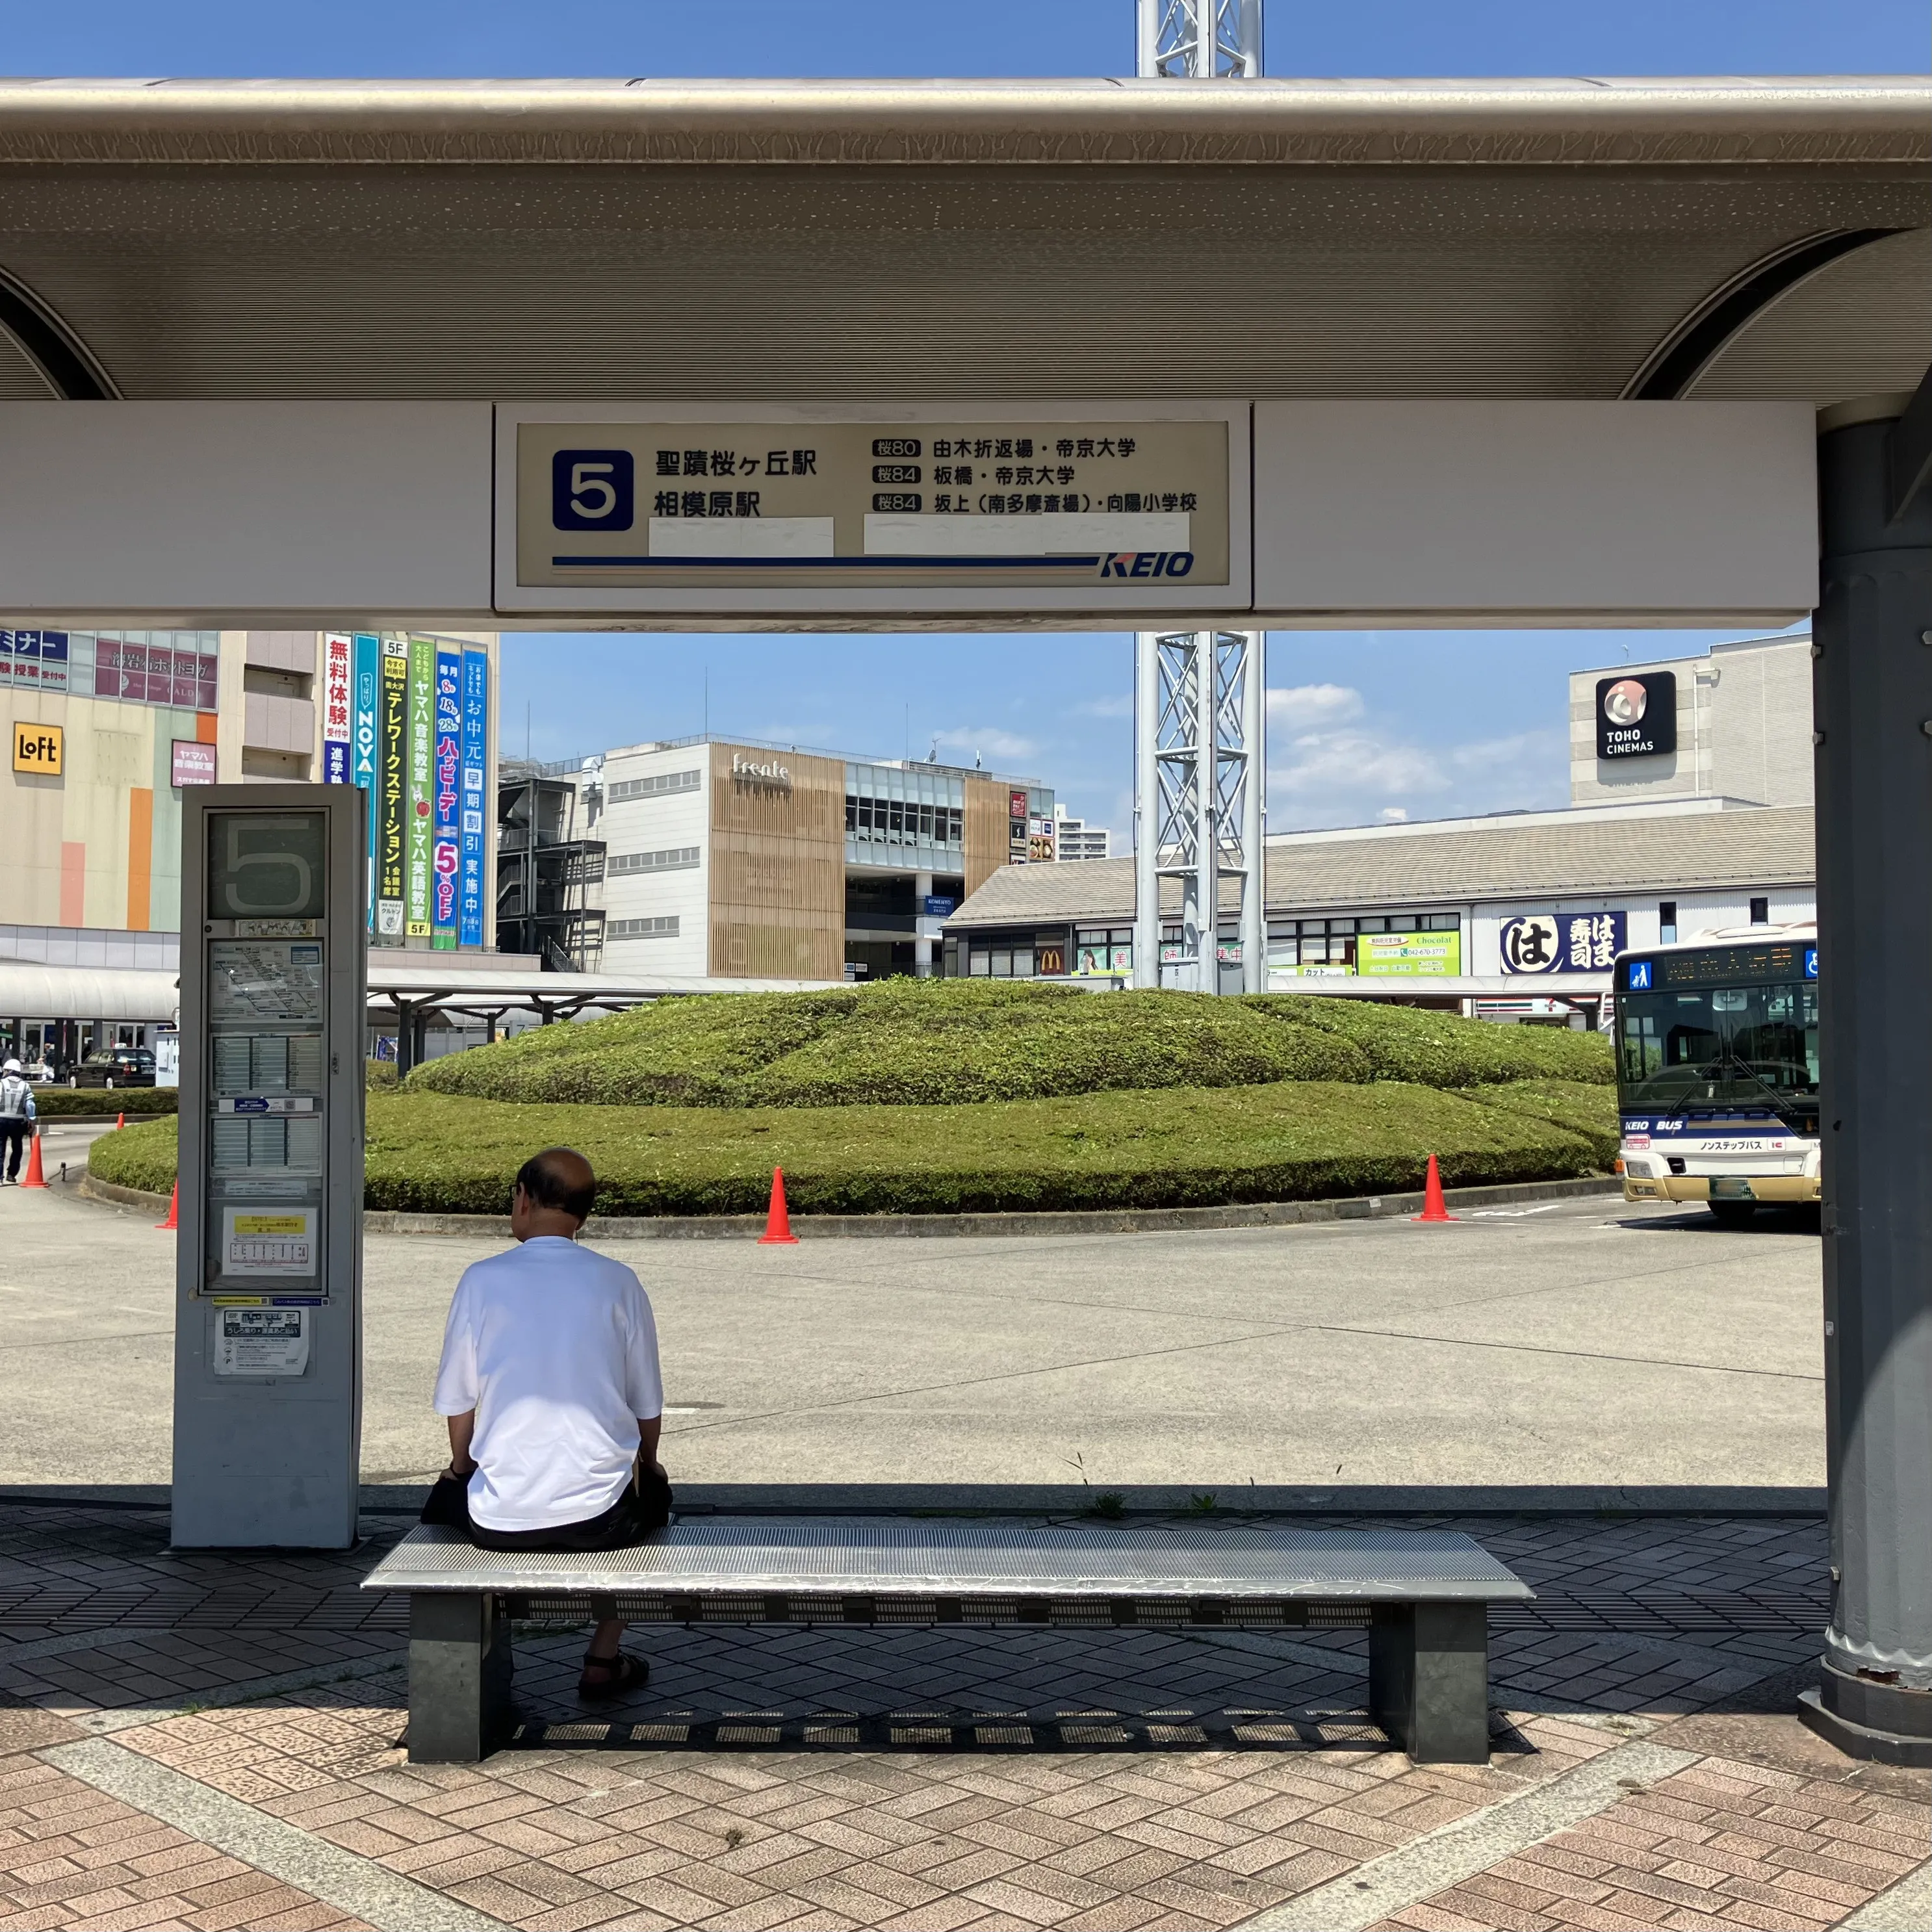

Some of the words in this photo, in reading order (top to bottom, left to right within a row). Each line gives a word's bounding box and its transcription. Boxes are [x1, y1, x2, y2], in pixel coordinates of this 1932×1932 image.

[877, 440, 917, 456] 桜80
[933, 439, 1136, 457] 由木折返場・帝京大学
[656, 450, 816, 476] 聖蹟桜ヶ丘駅
[877, 467, 917, 483] 桜84
[934, 466, 1075, 485] 板橋・帝京大学
[571, 463, 615, 518] 5
[654, 491, 760, 517] 相模原駅
[877, 493, 917, 510] 桜84
[1100, 552, 1194, 577] KEIO
[389, 642, 404, 654] 5F
[387, 659, 404, 668] 今すぐ
[439, 664, 458, 678] 毎月
[329, 640, 348, 727] 無料体験
[327, 728, 348, 740] 受付中
[413, 680, 430, 782] ヤマハ音楽教室
[467, 699, 482, 760] お中元
[1606, 728, 1641, 743] TOHO
[357, 710, 374, 772] NOVA
[1606, 740, 1654, 754] CINEMAS
[180, 751, 209, 761] ヤマハ
[385, 692, 403, 863] テレワークステーション
[438, 736, 459, 821] ハッピーデー
[465, 771, 480, 851] 早期割引
[225, 819, 311, 914] 5
[411, 819, 428, 920] ヤマハ英語教室
[465, 858, 479, 913] 実施中
[411, 924, 425, 934] 5F
[1417, 936, 1452, 945] Chocolat
[1511, 923, 1552, 966] は
[1114, 951, 1127, 967] 美
[1408, 948, 1445, 957] 042-670-3773
[1625, 1121, 1649, 1130] KEIO
[1656, 1121, 1683, 1130] BUS
[1701, 1141, 1762, 1150] ノンステップバス
